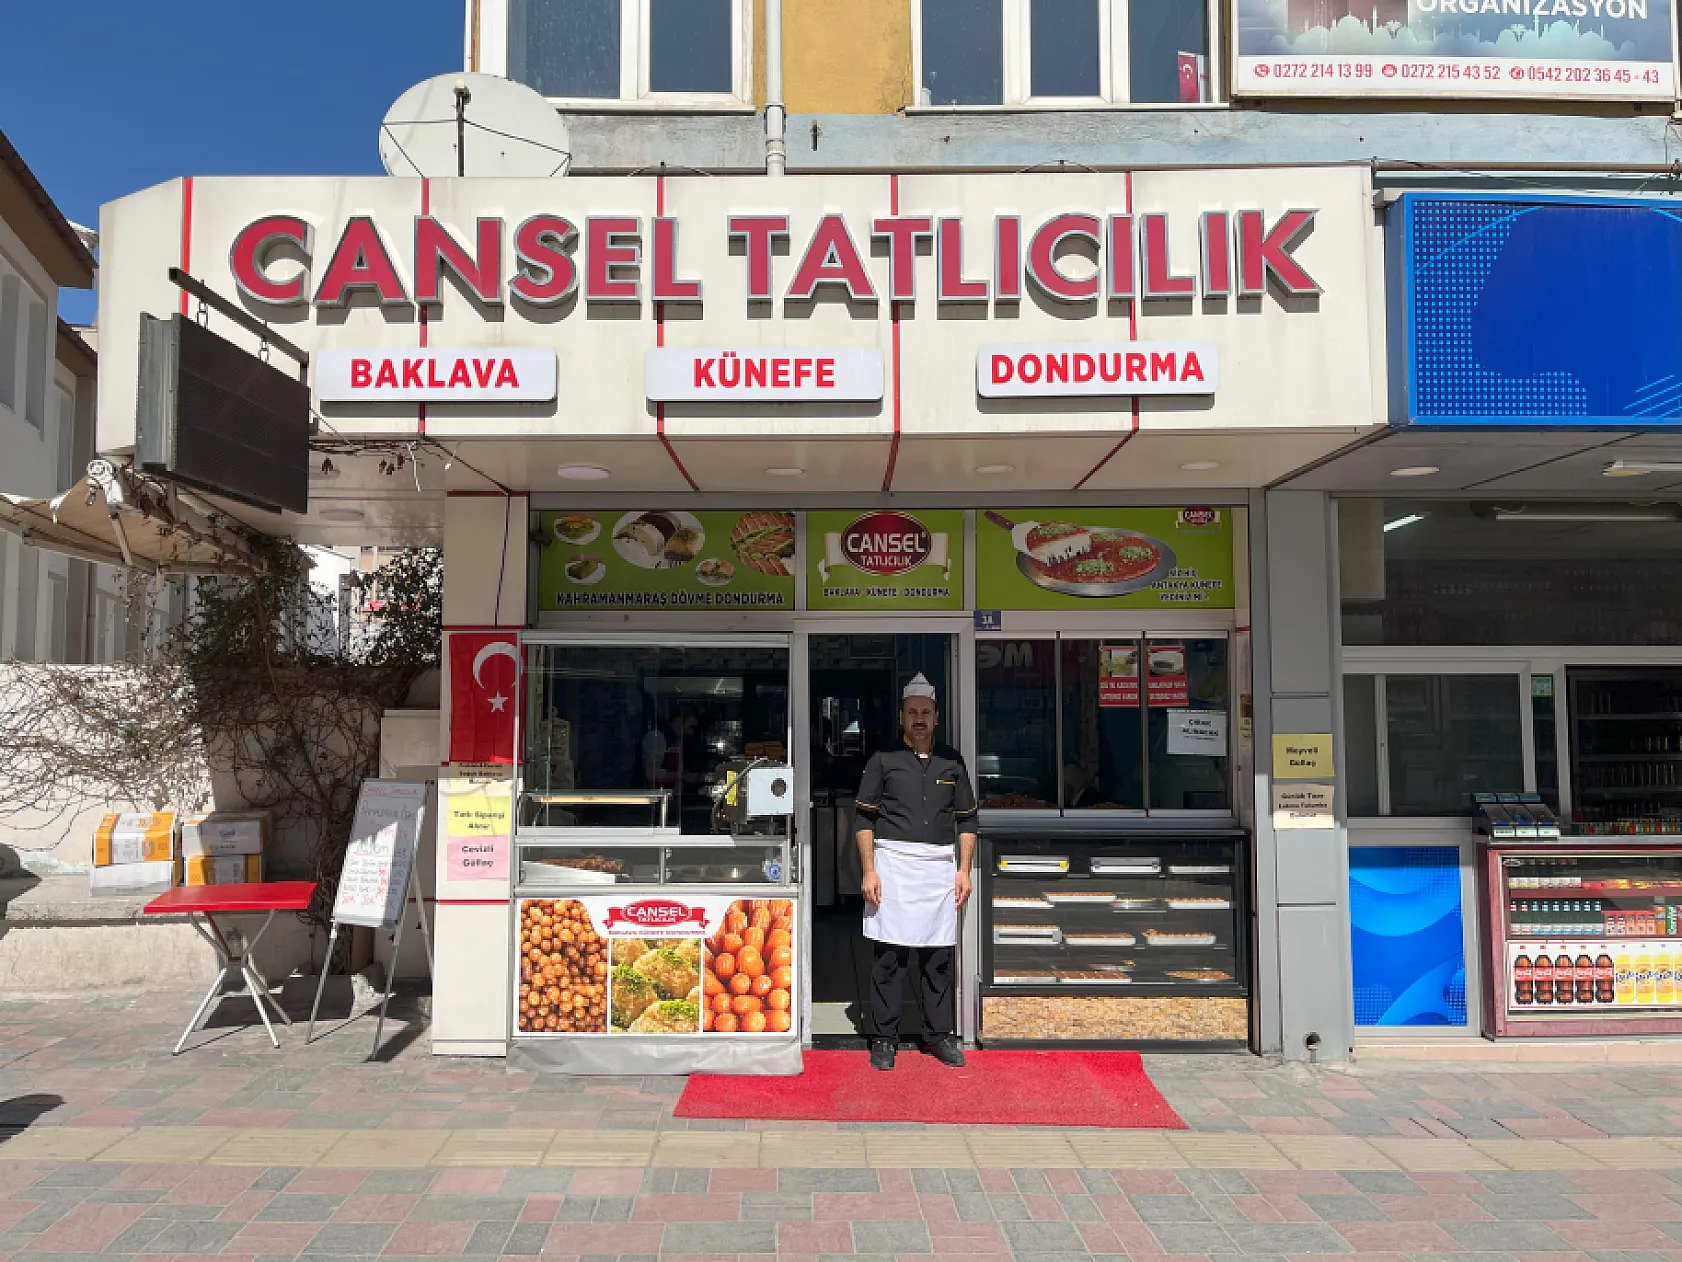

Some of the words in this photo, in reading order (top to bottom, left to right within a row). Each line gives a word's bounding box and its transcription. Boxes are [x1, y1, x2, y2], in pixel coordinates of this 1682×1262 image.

[1273, 63, 1308, 78] 0272
[1310, 63, 1335, 78] 214
[1338, 63, 1352, 78] 13
[1355, 63, 1373, 78] 99
[1401, 64, 1434, 79] 0272
[1437, 64, 1460, 79] 215
[1462, 65, 1480, 80] 43
[1483, 65, 1501, 80] 52
[1528, 66, 1562, 82] 0542
[1565, 67, 1590, 82] 202
[1594, 67, 1611, 82] 36
[1613, 69, 1631, 83] 45
[1642, 69, 1659, 84] 43
[229, 213, 703, 309] CANSEL
[726, 208, 1325, 301] TATLICILIK
[350, 358, 519, 388] BAKLAVA
[693, 350, 836, 389] KÜNEFE
[991, 352, 1205, 385] DONDURMA
[847, 532, 926, 553] CANSEL
[860, 555, 912, 567] TATLICILIK
[556, 592, 668, 607] KAHRAMANMARAŞ
[670, 590, 712, 605] DÖVME
[715, 592, 784, 605] DONDURMA
[627, 907, 686, 917] CANSEL
